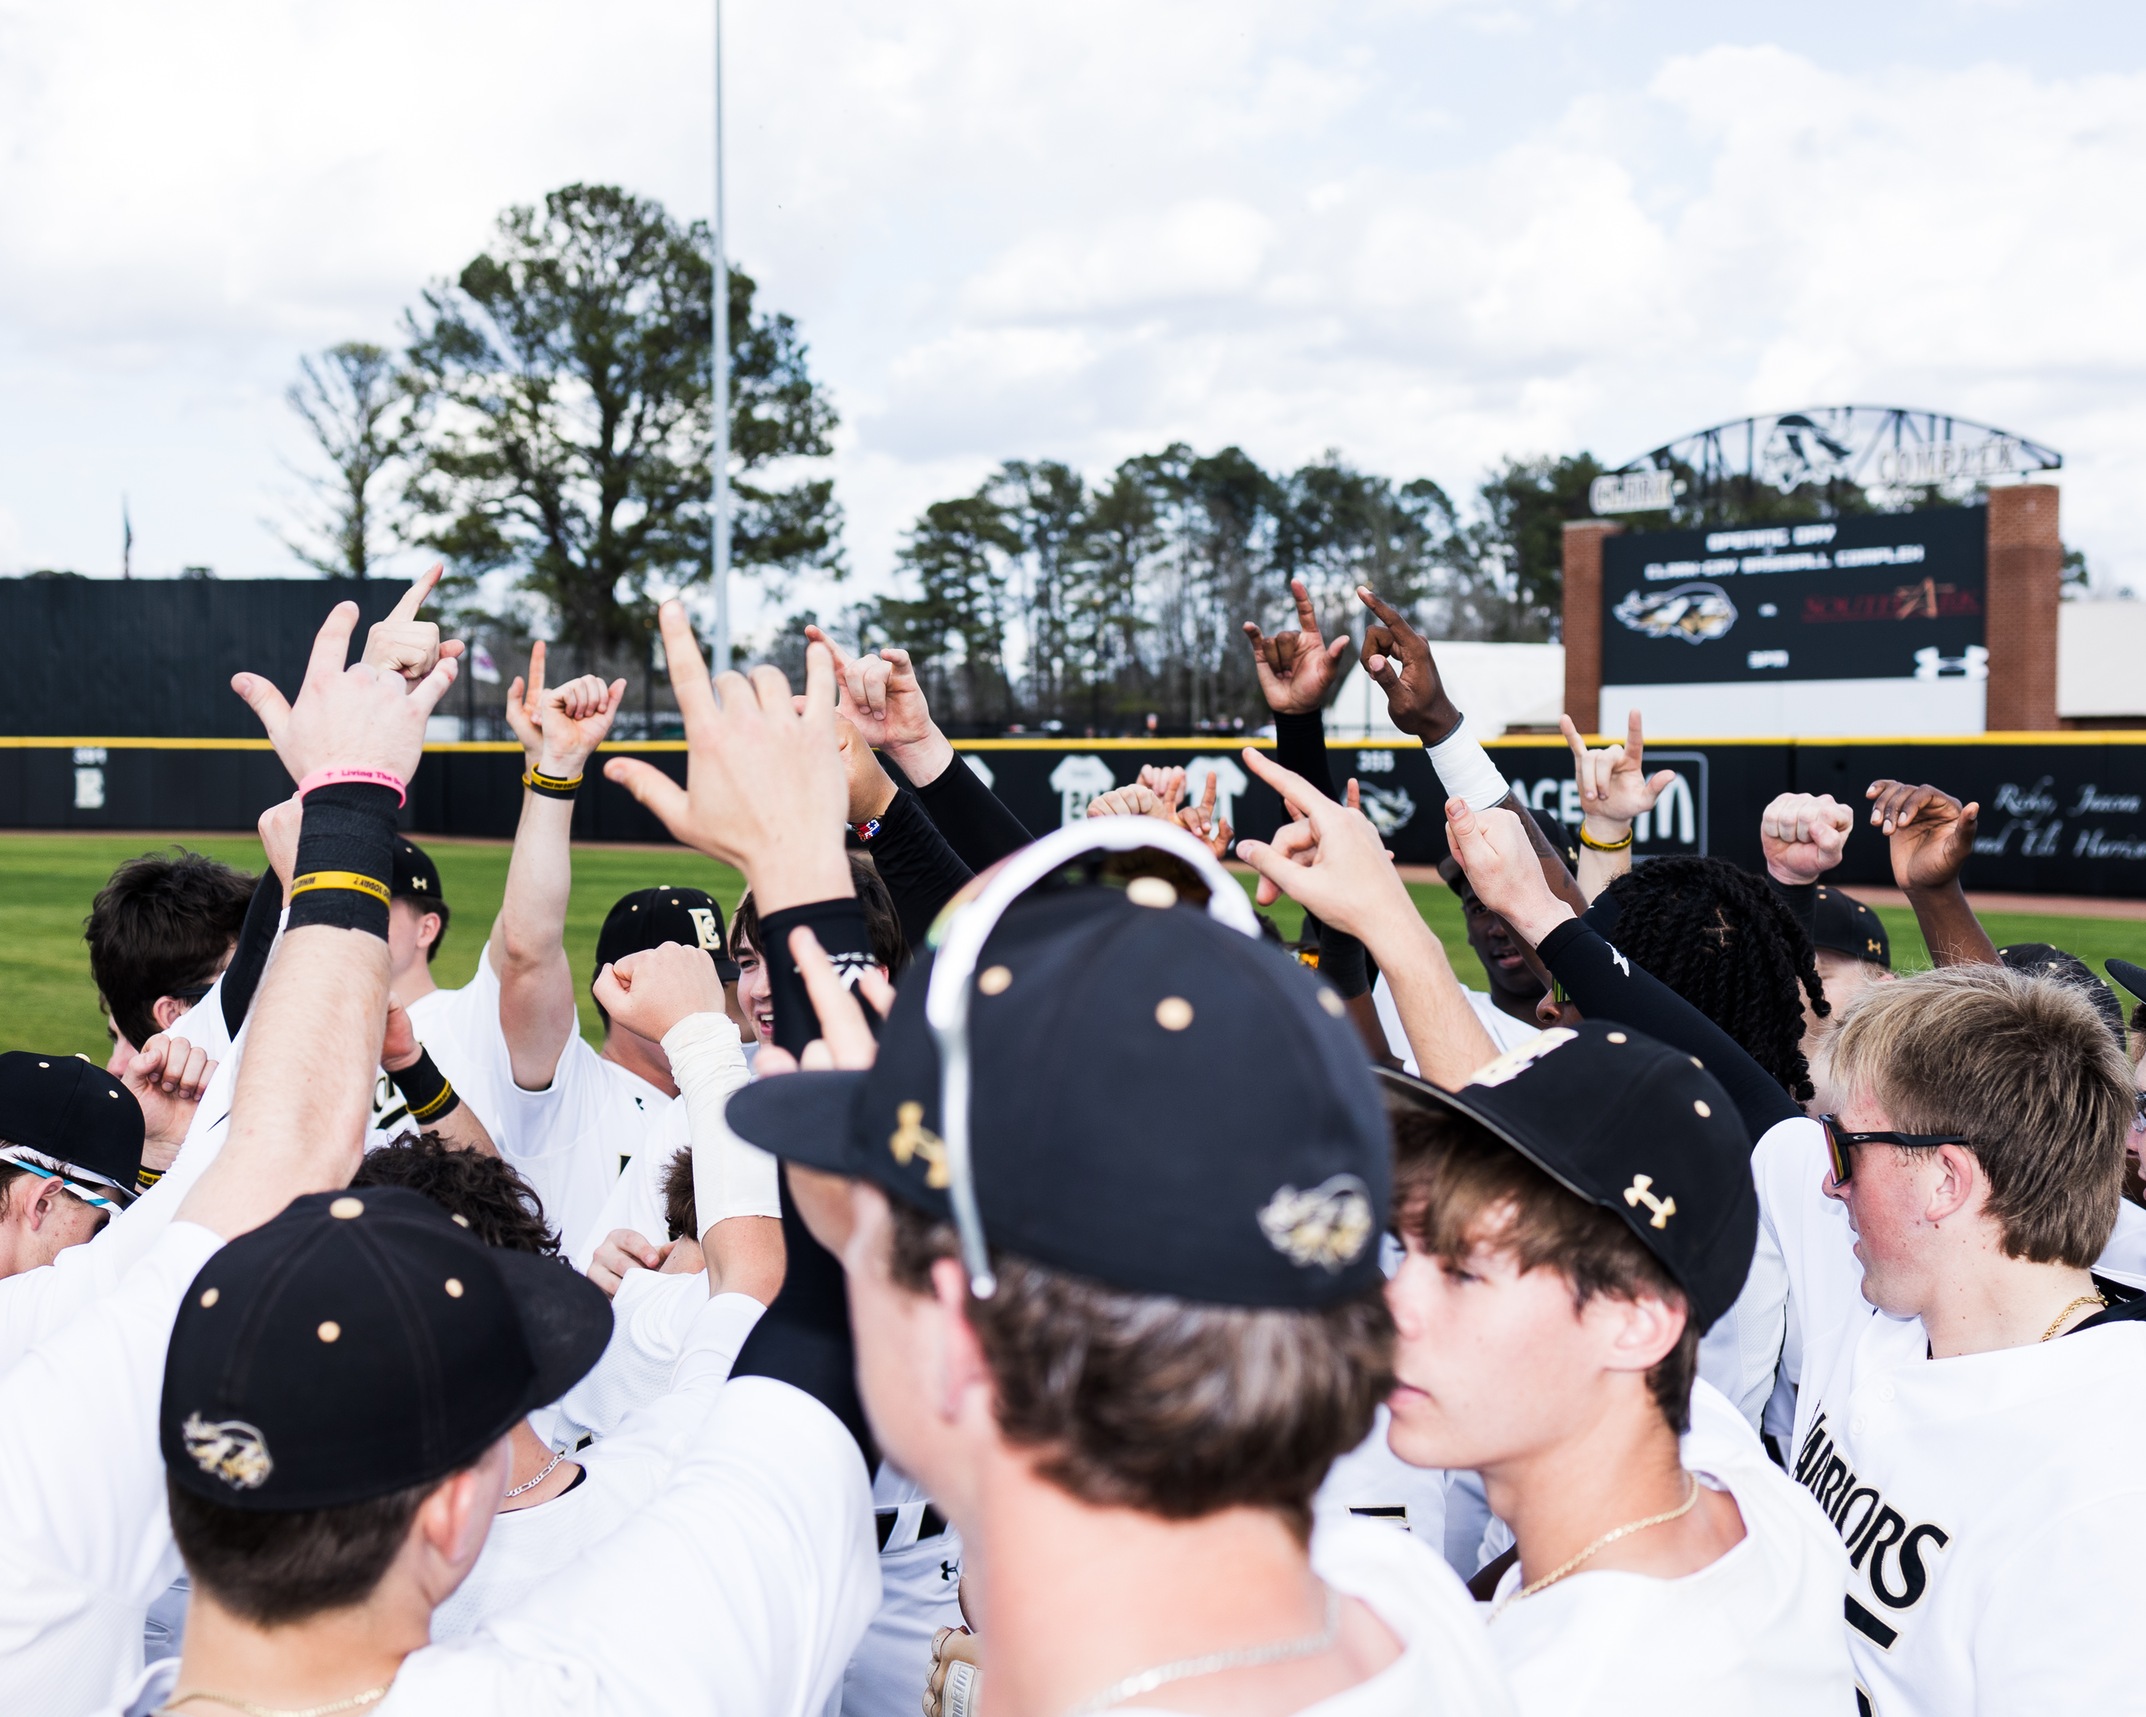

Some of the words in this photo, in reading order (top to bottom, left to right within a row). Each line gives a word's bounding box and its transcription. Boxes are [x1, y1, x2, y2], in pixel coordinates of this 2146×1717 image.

[1792, 523, 1837, 546] DAY
[1741, 552, 1833, 574] BASEBALL
[1835, 544, 1925, 568] COMPLEX
[341, 769, 373, 778] Living
[376, 771, 392, 781] The
